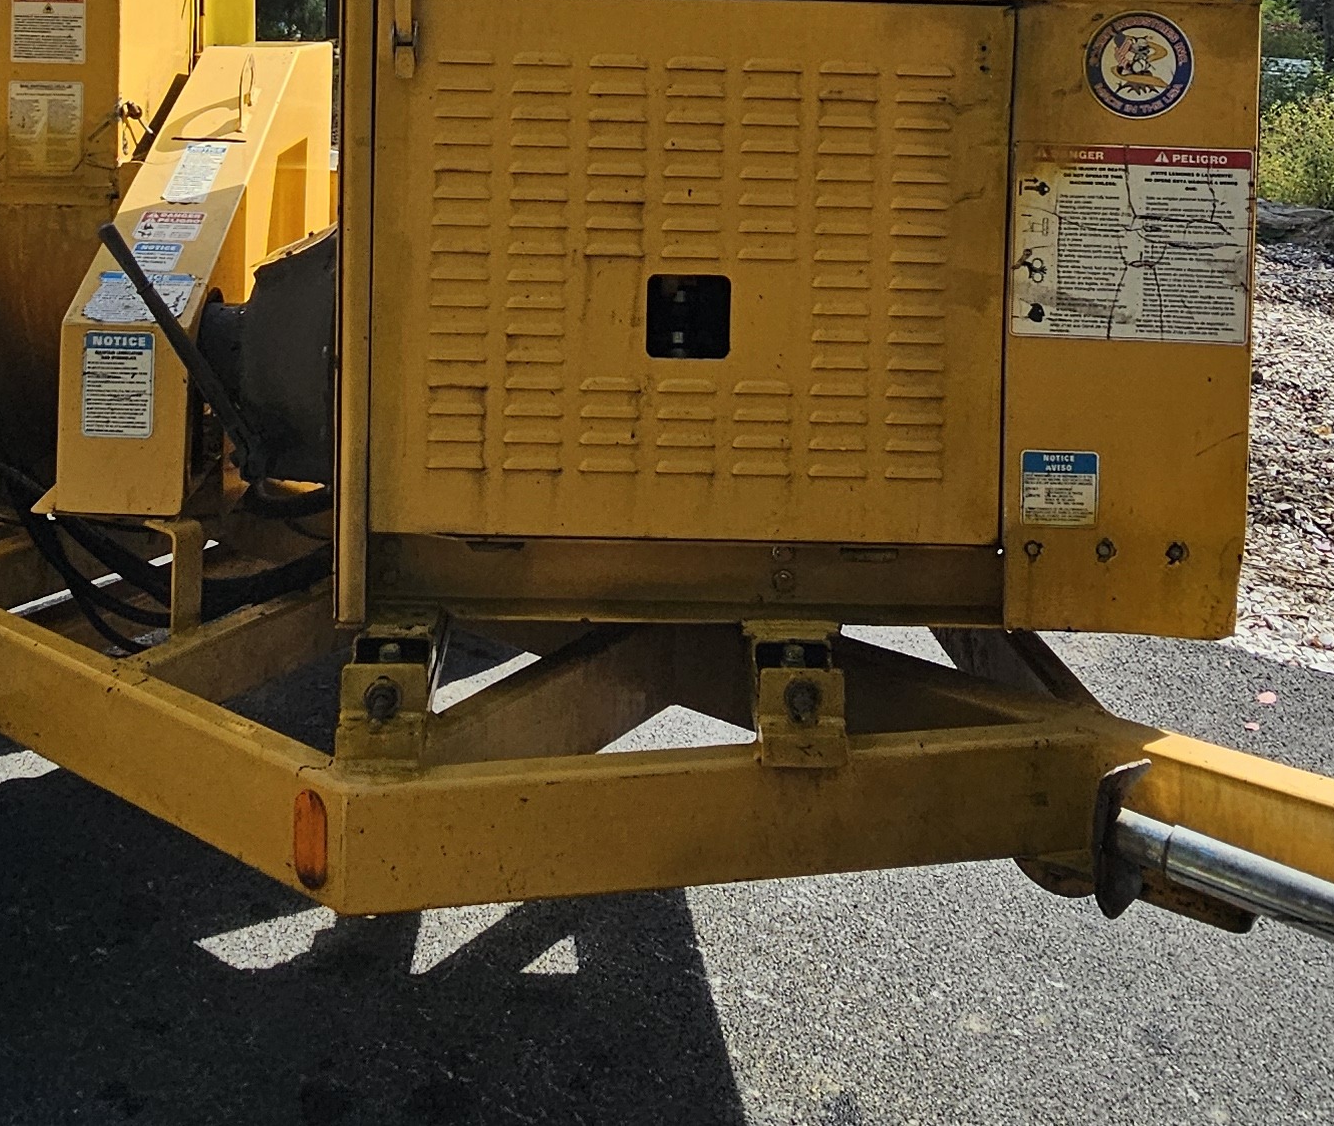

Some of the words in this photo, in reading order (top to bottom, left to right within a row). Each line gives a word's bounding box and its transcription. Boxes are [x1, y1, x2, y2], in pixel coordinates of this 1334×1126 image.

[1172, 154, 1228, 165] PELIGRO
[92, 335, 146, 347] NOTICE
[1042, 454, 1075, 463] NOTICE
[1045, 464, 1073, 472] AVISO
